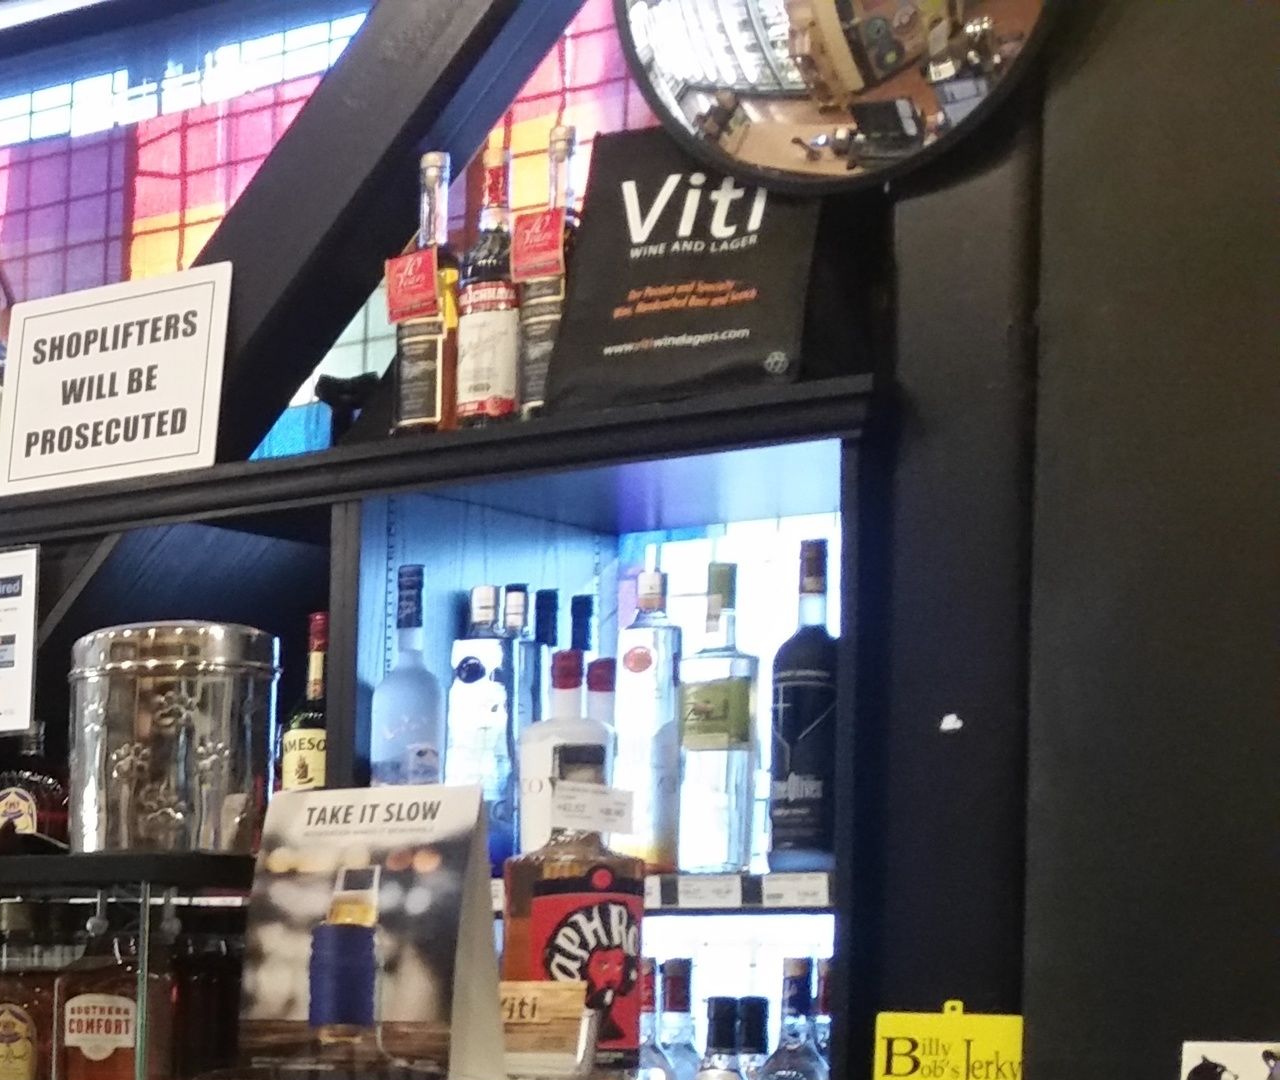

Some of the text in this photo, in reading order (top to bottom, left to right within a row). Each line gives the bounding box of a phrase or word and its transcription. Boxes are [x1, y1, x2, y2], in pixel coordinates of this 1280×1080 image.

[630, 233, 759, 259] WINE AND LAGER
[32, 309, 199, 366] SHOPLIFTERS
[60, 364, 159, 406] WILL BE
[24, 407, 188, 458] PROSECUTED
[305, 799, 442, 827] TAKE IT SLOW
[68, 1017, 132, 1036] COMFORT
